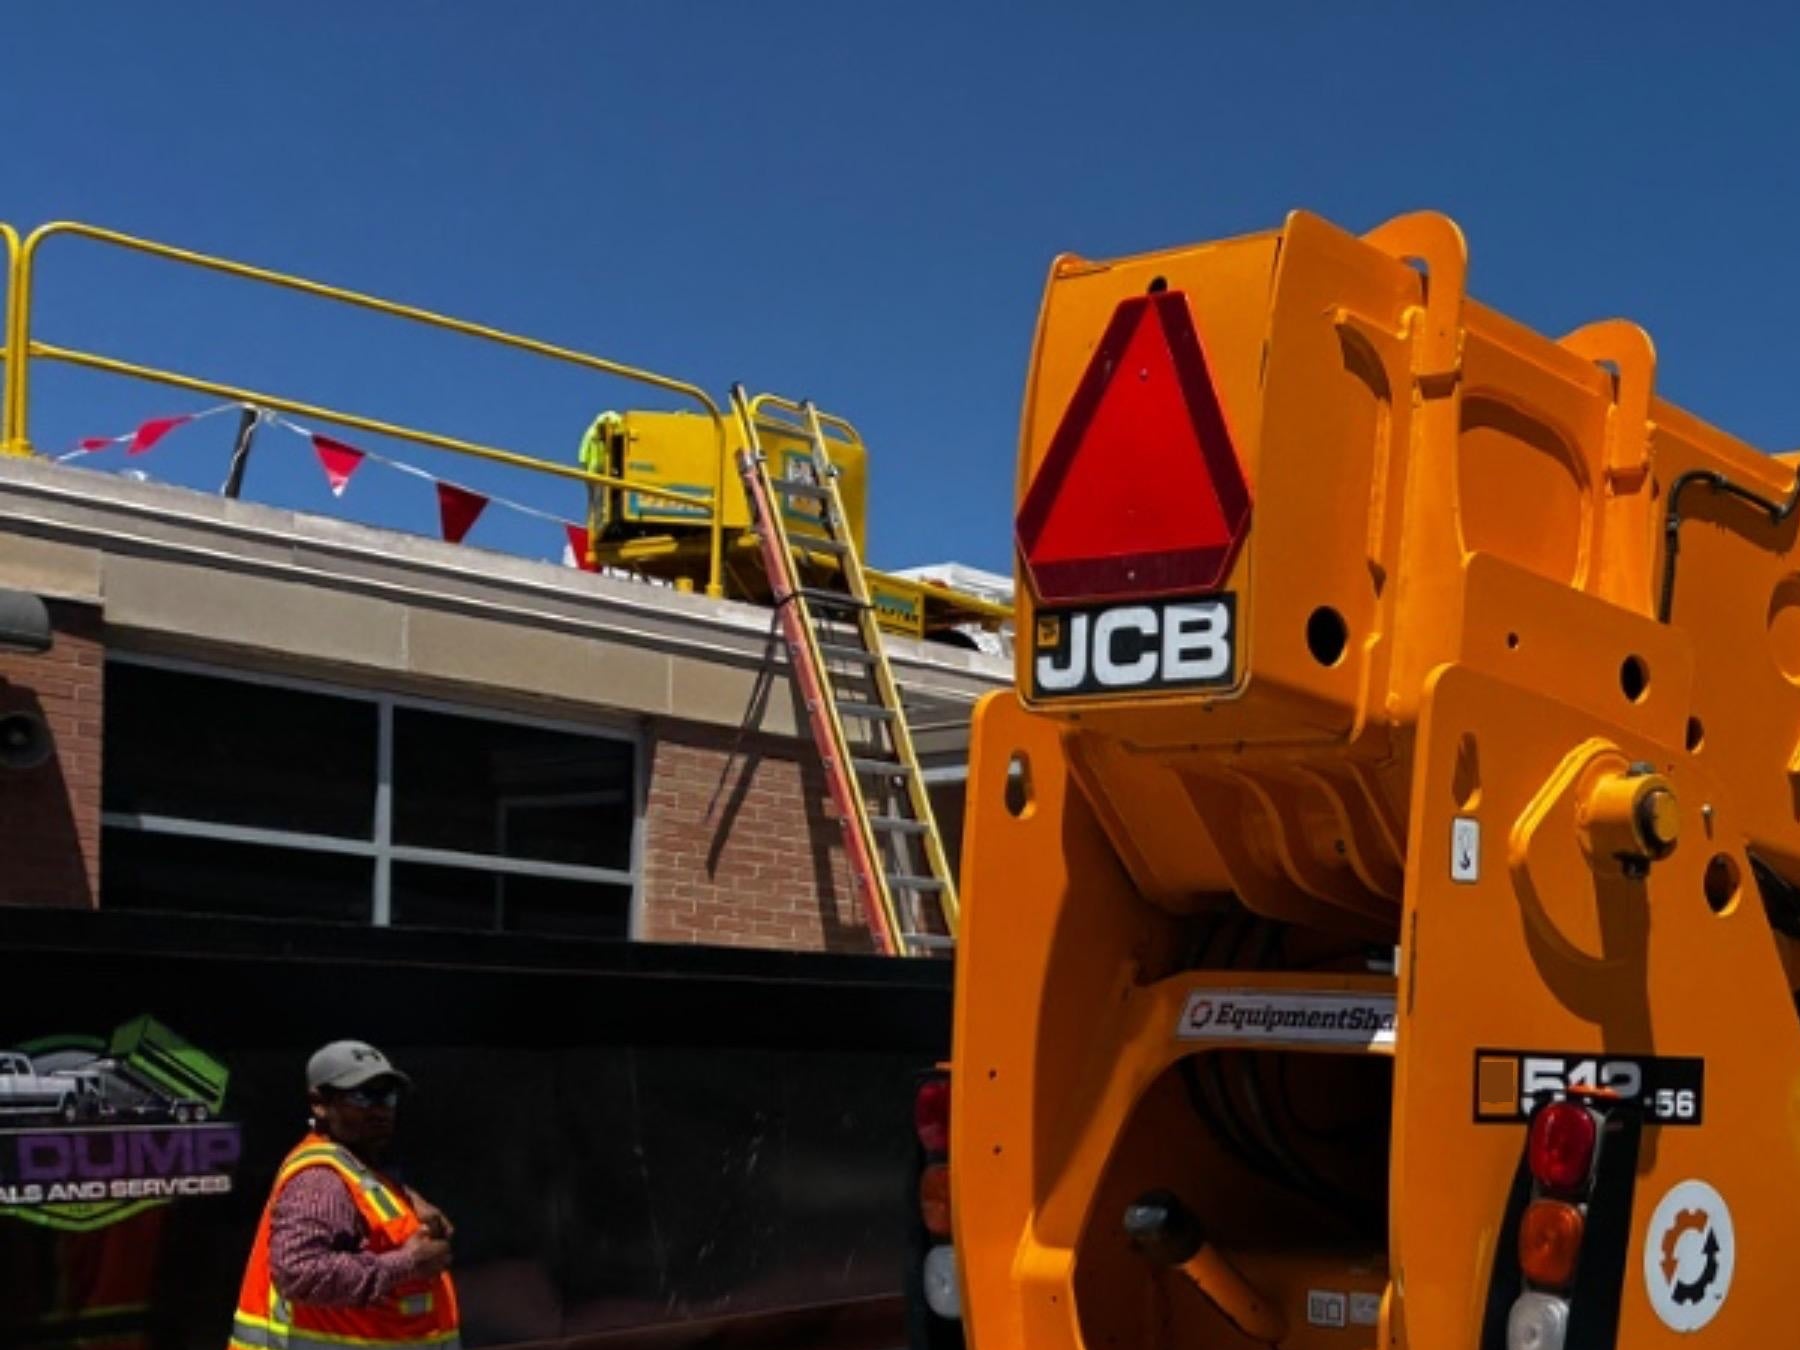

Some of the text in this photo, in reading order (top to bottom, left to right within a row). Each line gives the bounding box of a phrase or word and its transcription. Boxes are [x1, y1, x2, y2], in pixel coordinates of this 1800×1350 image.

[1037, 602, 1231, 690] JCB
[17, 1128, 241, 1181] DUMP
[47, 1179, 106, 1201] AND
[109, 1174, 232, 1198] SERVICES
